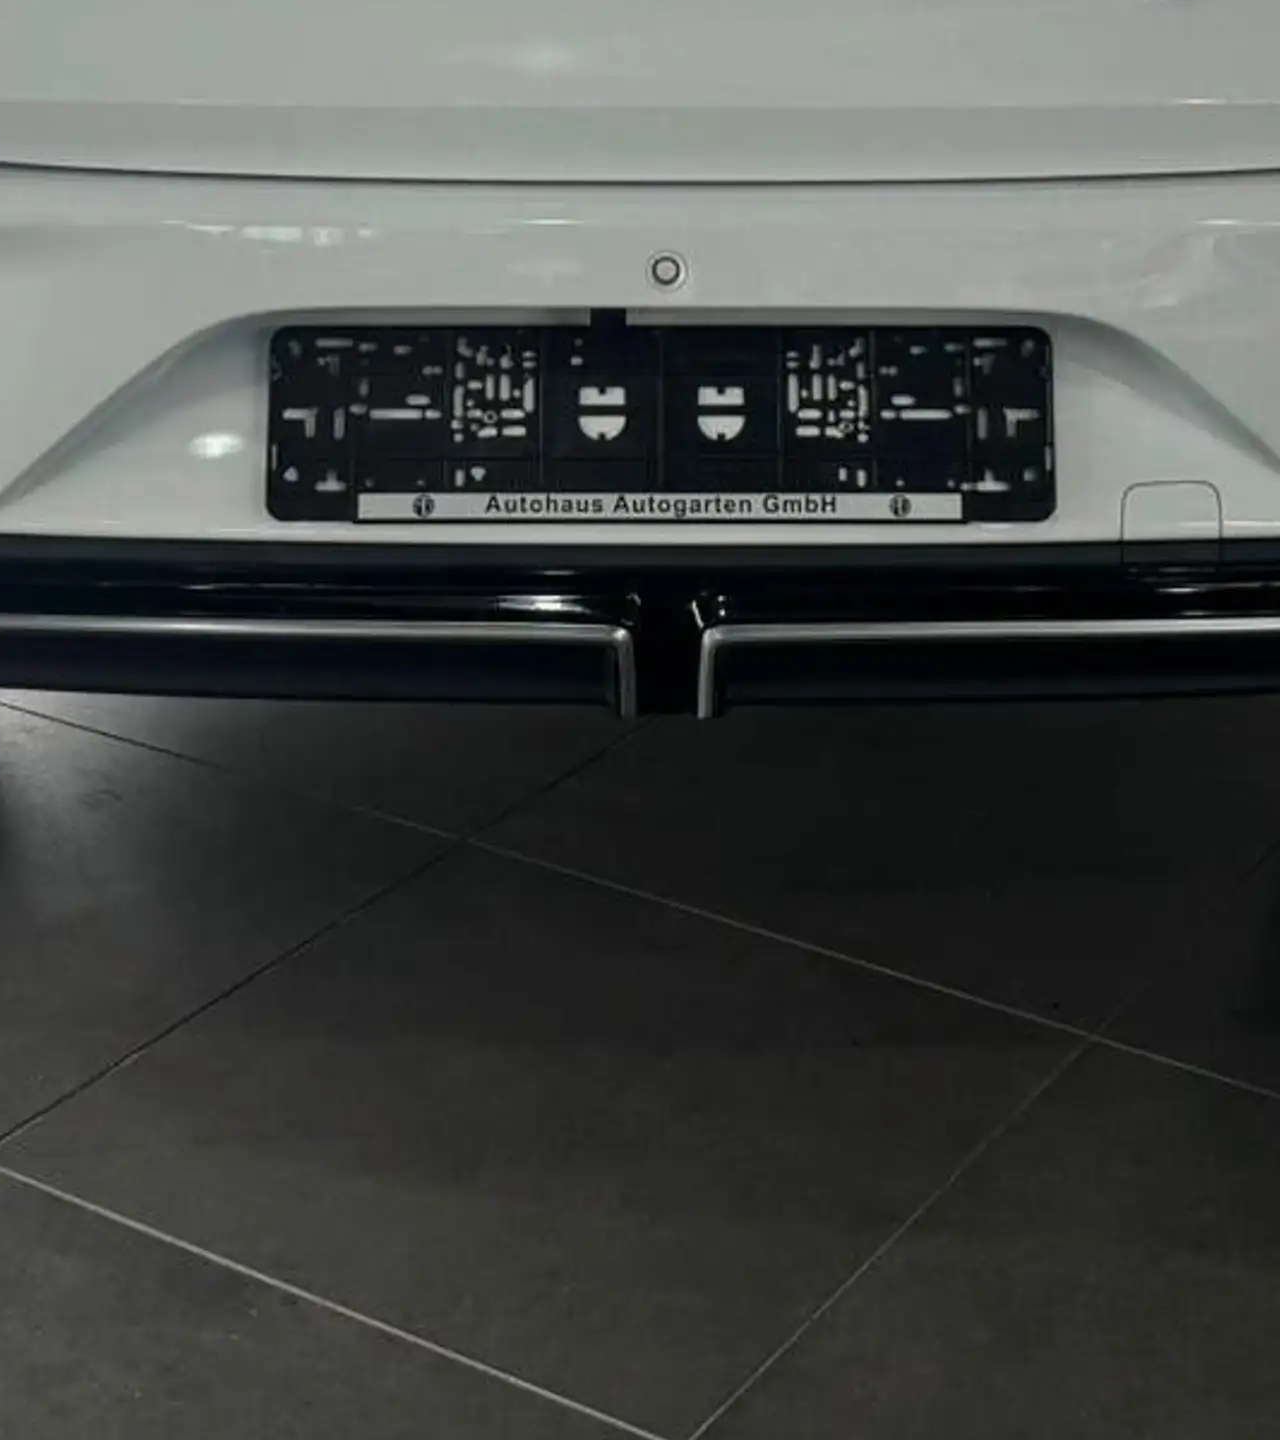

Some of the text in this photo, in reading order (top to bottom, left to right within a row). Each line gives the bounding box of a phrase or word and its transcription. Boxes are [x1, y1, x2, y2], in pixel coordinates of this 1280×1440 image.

[484, 494, 838, 518] Autohaus Autogarten GmbH
